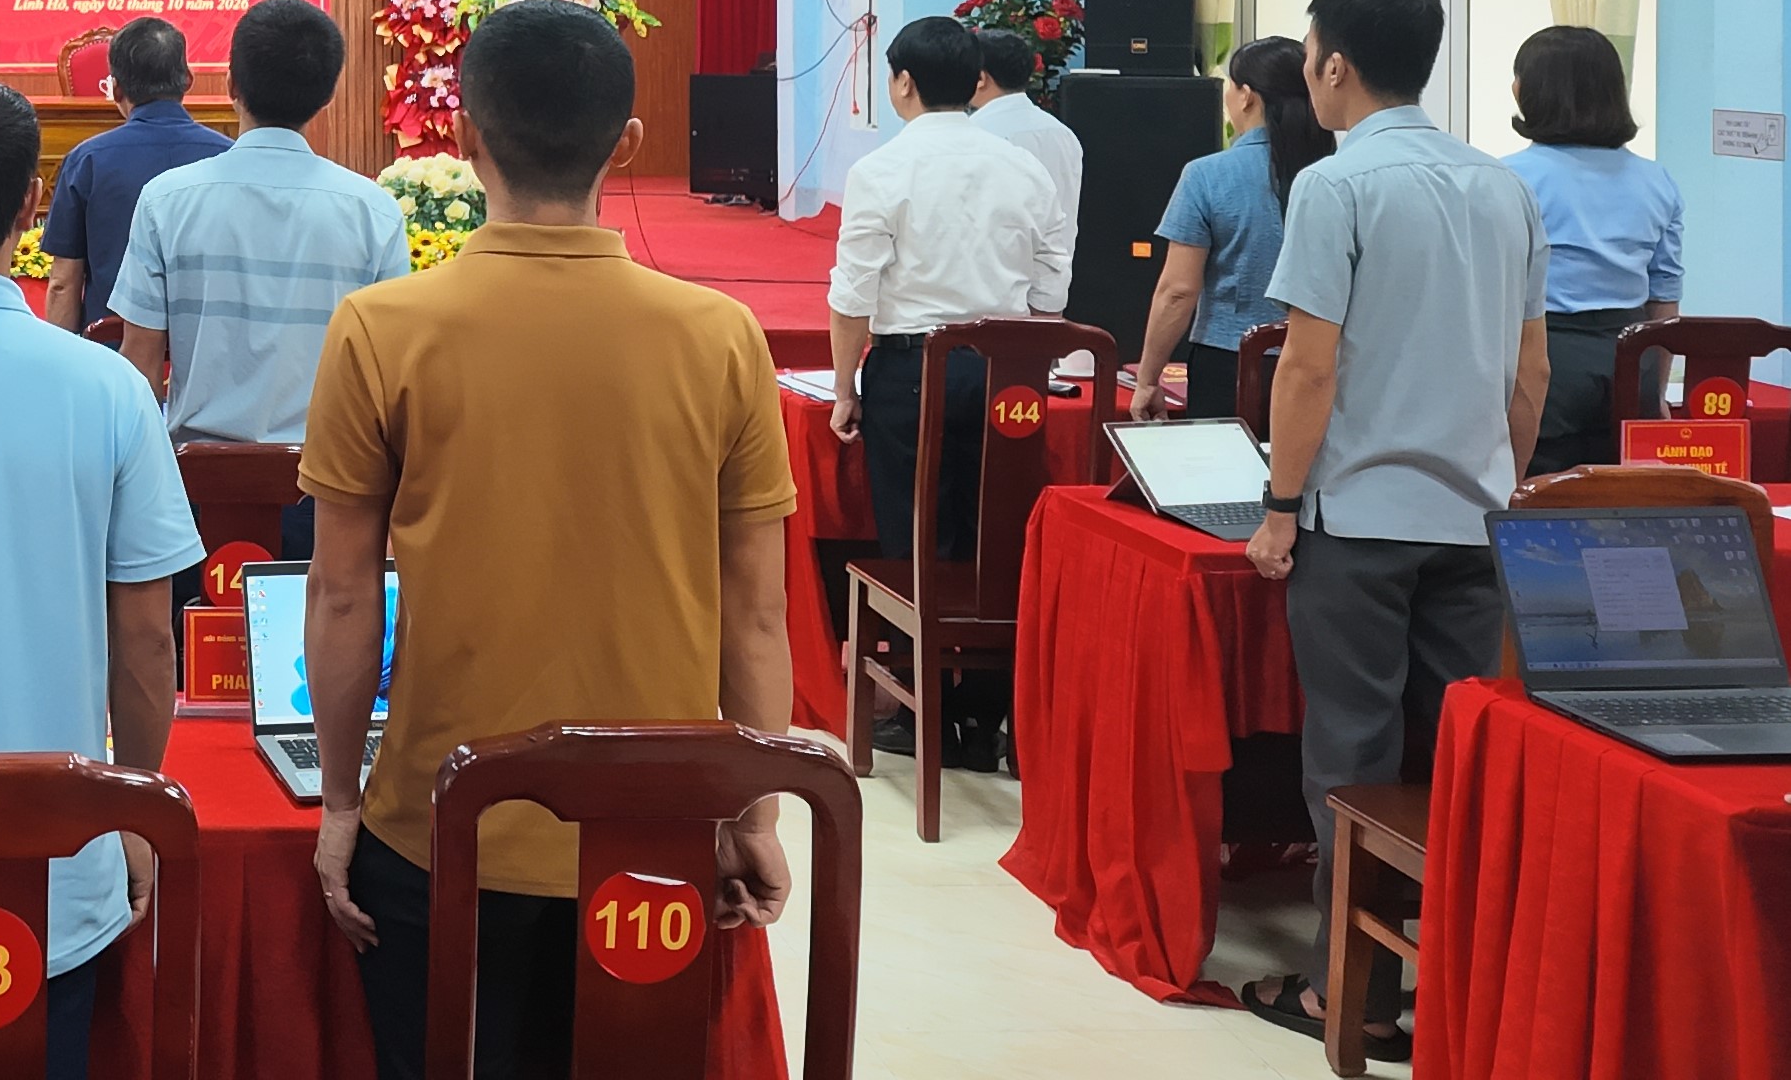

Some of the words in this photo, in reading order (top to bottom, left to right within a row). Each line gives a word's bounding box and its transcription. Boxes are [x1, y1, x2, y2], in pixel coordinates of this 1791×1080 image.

[994, 400, 1040, 425] 144
[1704, 392, 1731, 416] 89
[1657, 445, 1686, 458] LÃNH
[1690, 446, 1713, 460] ĐẠO
[595, 901, 691, 950] 110
